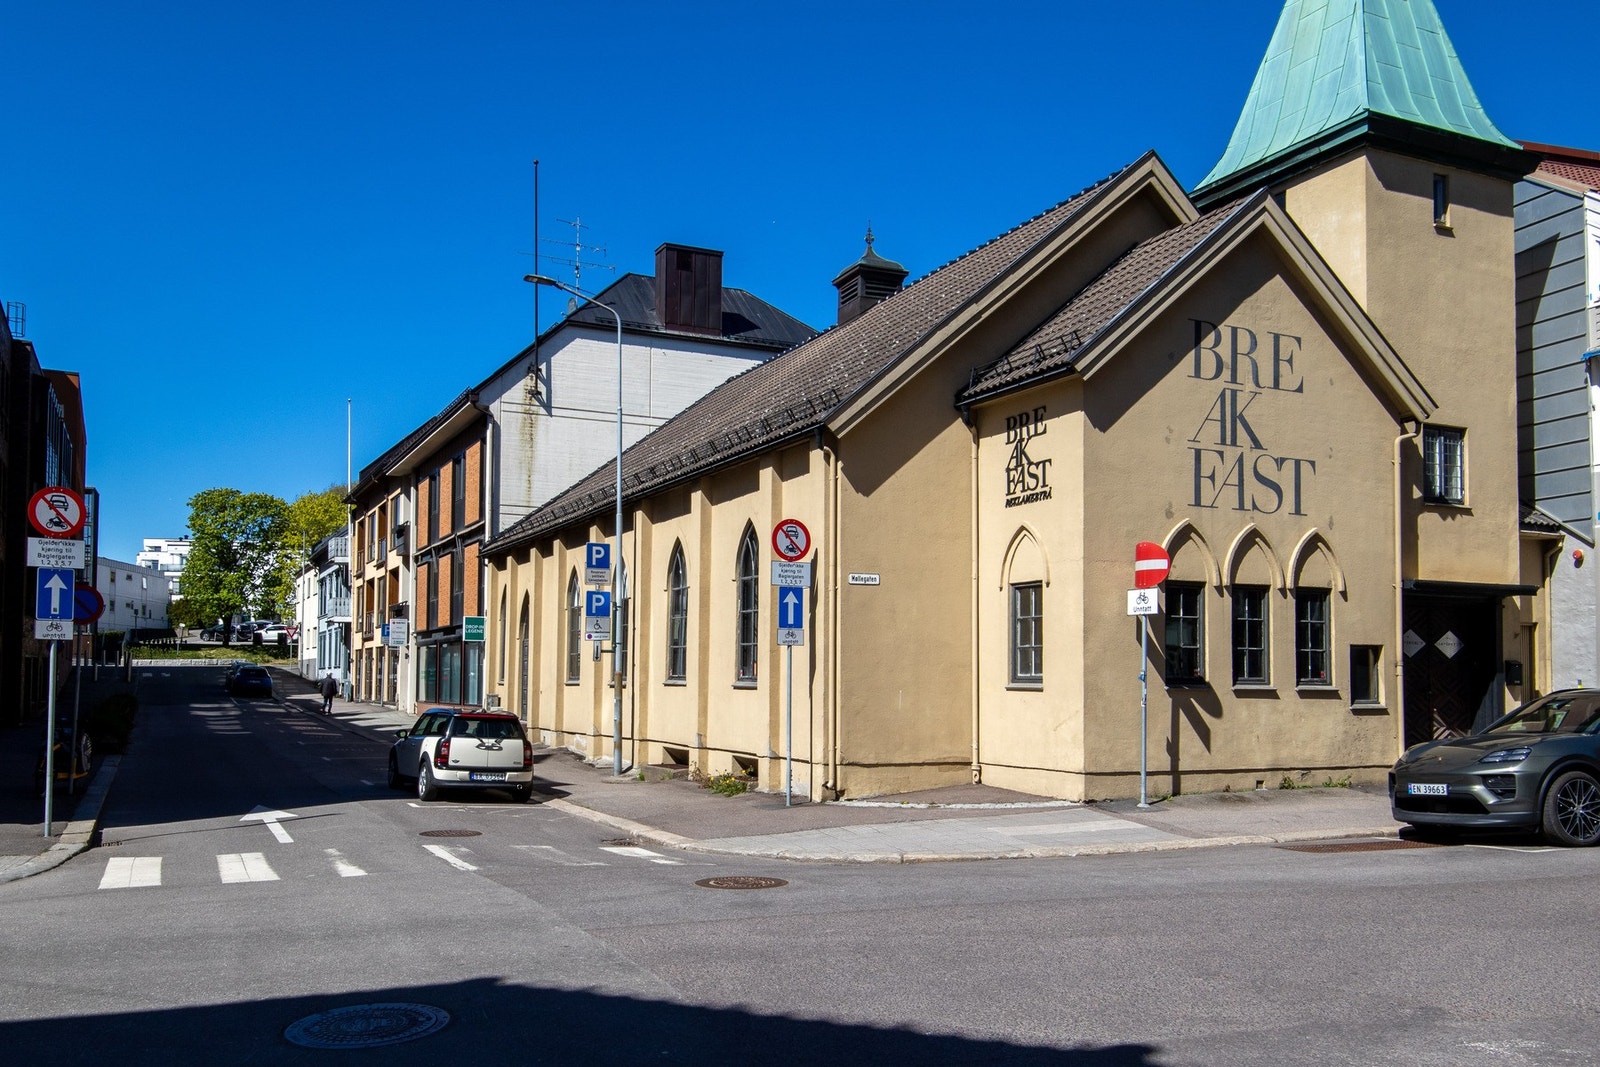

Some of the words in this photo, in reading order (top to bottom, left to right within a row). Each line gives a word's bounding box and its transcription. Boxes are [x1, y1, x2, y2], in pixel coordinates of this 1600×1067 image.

[1187, 318, 1304, 394] BRE
[1005, 405, 1047, 445] BRE
[1187, 387, 1268, 450] AK
[1005, 436, 1034, 470] AK
[1005, 458, 1052, 496] FAST
[1187, 447, 1316, 516] FAST
[37, 552, 76, 560] Baglergaten
[41, 546, 63, 554] kjøring
[592, 546, 605, 566] P
[851, 575, 877, 583] Møllegaten
[592, 594, 605, 614] P
[1412, 784, 1421, 793] EN
[1423, 785, 1446, 794] 39663
